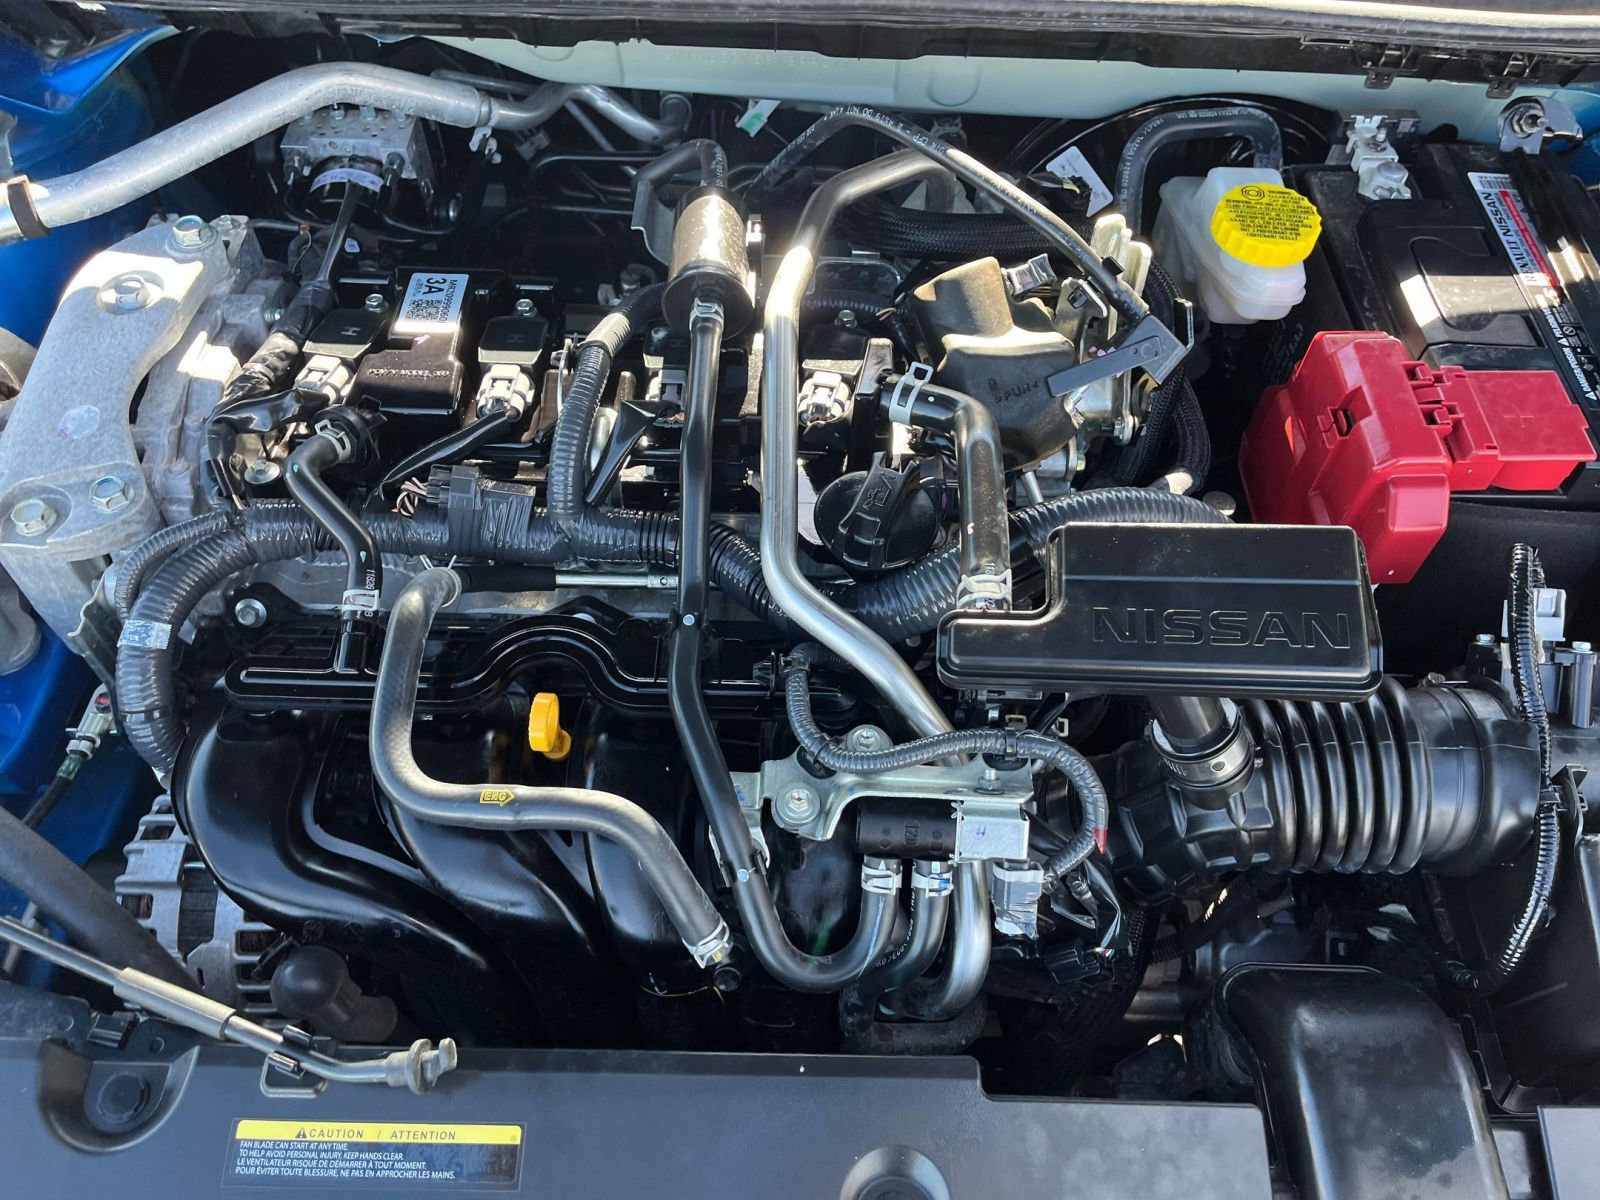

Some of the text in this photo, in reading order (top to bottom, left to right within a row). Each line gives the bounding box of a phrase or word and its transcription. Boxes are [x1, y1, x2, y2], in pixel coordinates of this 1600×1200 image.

[1481, 191, 1514, 237] NISSAN
[422, 277, 448, 295] 3A
[1092, 606, 1351, 650] NISSAN
[308, 1127, 364, 1139] CAUTION
[390, 1129, 456, 1141] ATTENTION
[239, 1140, 253, 1149] FAN
[253, 1140, 274, 1150] BLADE
[275, 1141, 288, 1150] CAN
[289, 1141, 309, 1151] START
[309, 1142, 318, 1151] AT
[317, 1142, 332, 1151] ANY
[239, 1148, 249, 1158] TO
[248, 1149, 266, 1158] HELP
[265, 1149, 286, 1159] AVOID
[286, 1150, 319, 1160] PERSONAL
[343, 1151, 359, 1160] KEEP
[359, 1151, 382, 1161] HANDS
[236, 1157, 246, 1166] LE
[246, 1158, 292, 1168] VENTILATEUR
[292, 1159, 318, 1169] RISQUE
[318, 1160, 329, 1169] DE
[328, 1159, 367, 1170] DÉMARRER
[374, 1161, 394, 1170] TOUT
[235, 1166, 256, 1176] POUR
[256, 1165, 280, 1176] ÉVITER
[279, 1167, 304, 1177] TOUTE
[339, 1168, 350, 1177] NE
[349, 1169, 365, 1178] PAS
[364, 1169, 375, 1178] EN
[375, 1170, 418, 1179] APPROCHER
[418, 1170, 431, 1179] LES
[430, 1170, 457, 1180] MAINS.
